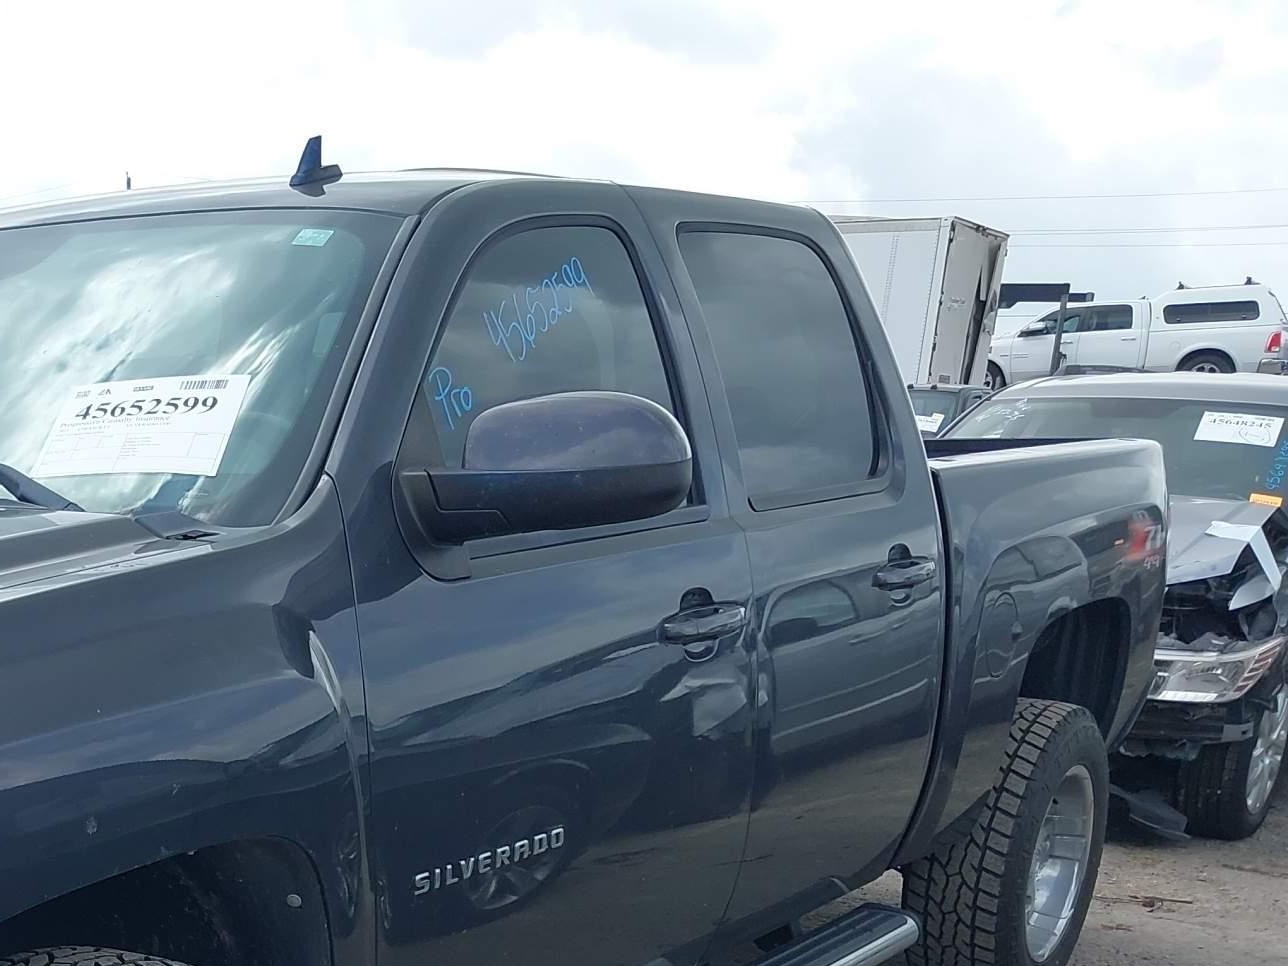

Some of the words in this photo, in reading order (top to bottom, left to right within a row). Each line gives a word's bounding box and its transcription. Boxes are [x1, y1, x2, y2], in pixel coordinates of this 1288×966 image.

[482, 256, 596, 362] 45652599
[75, 396, 219, 420] 45652599
[428, 367, 473, 431] Pro
[414, 827, 565, 896] SILVERADO
